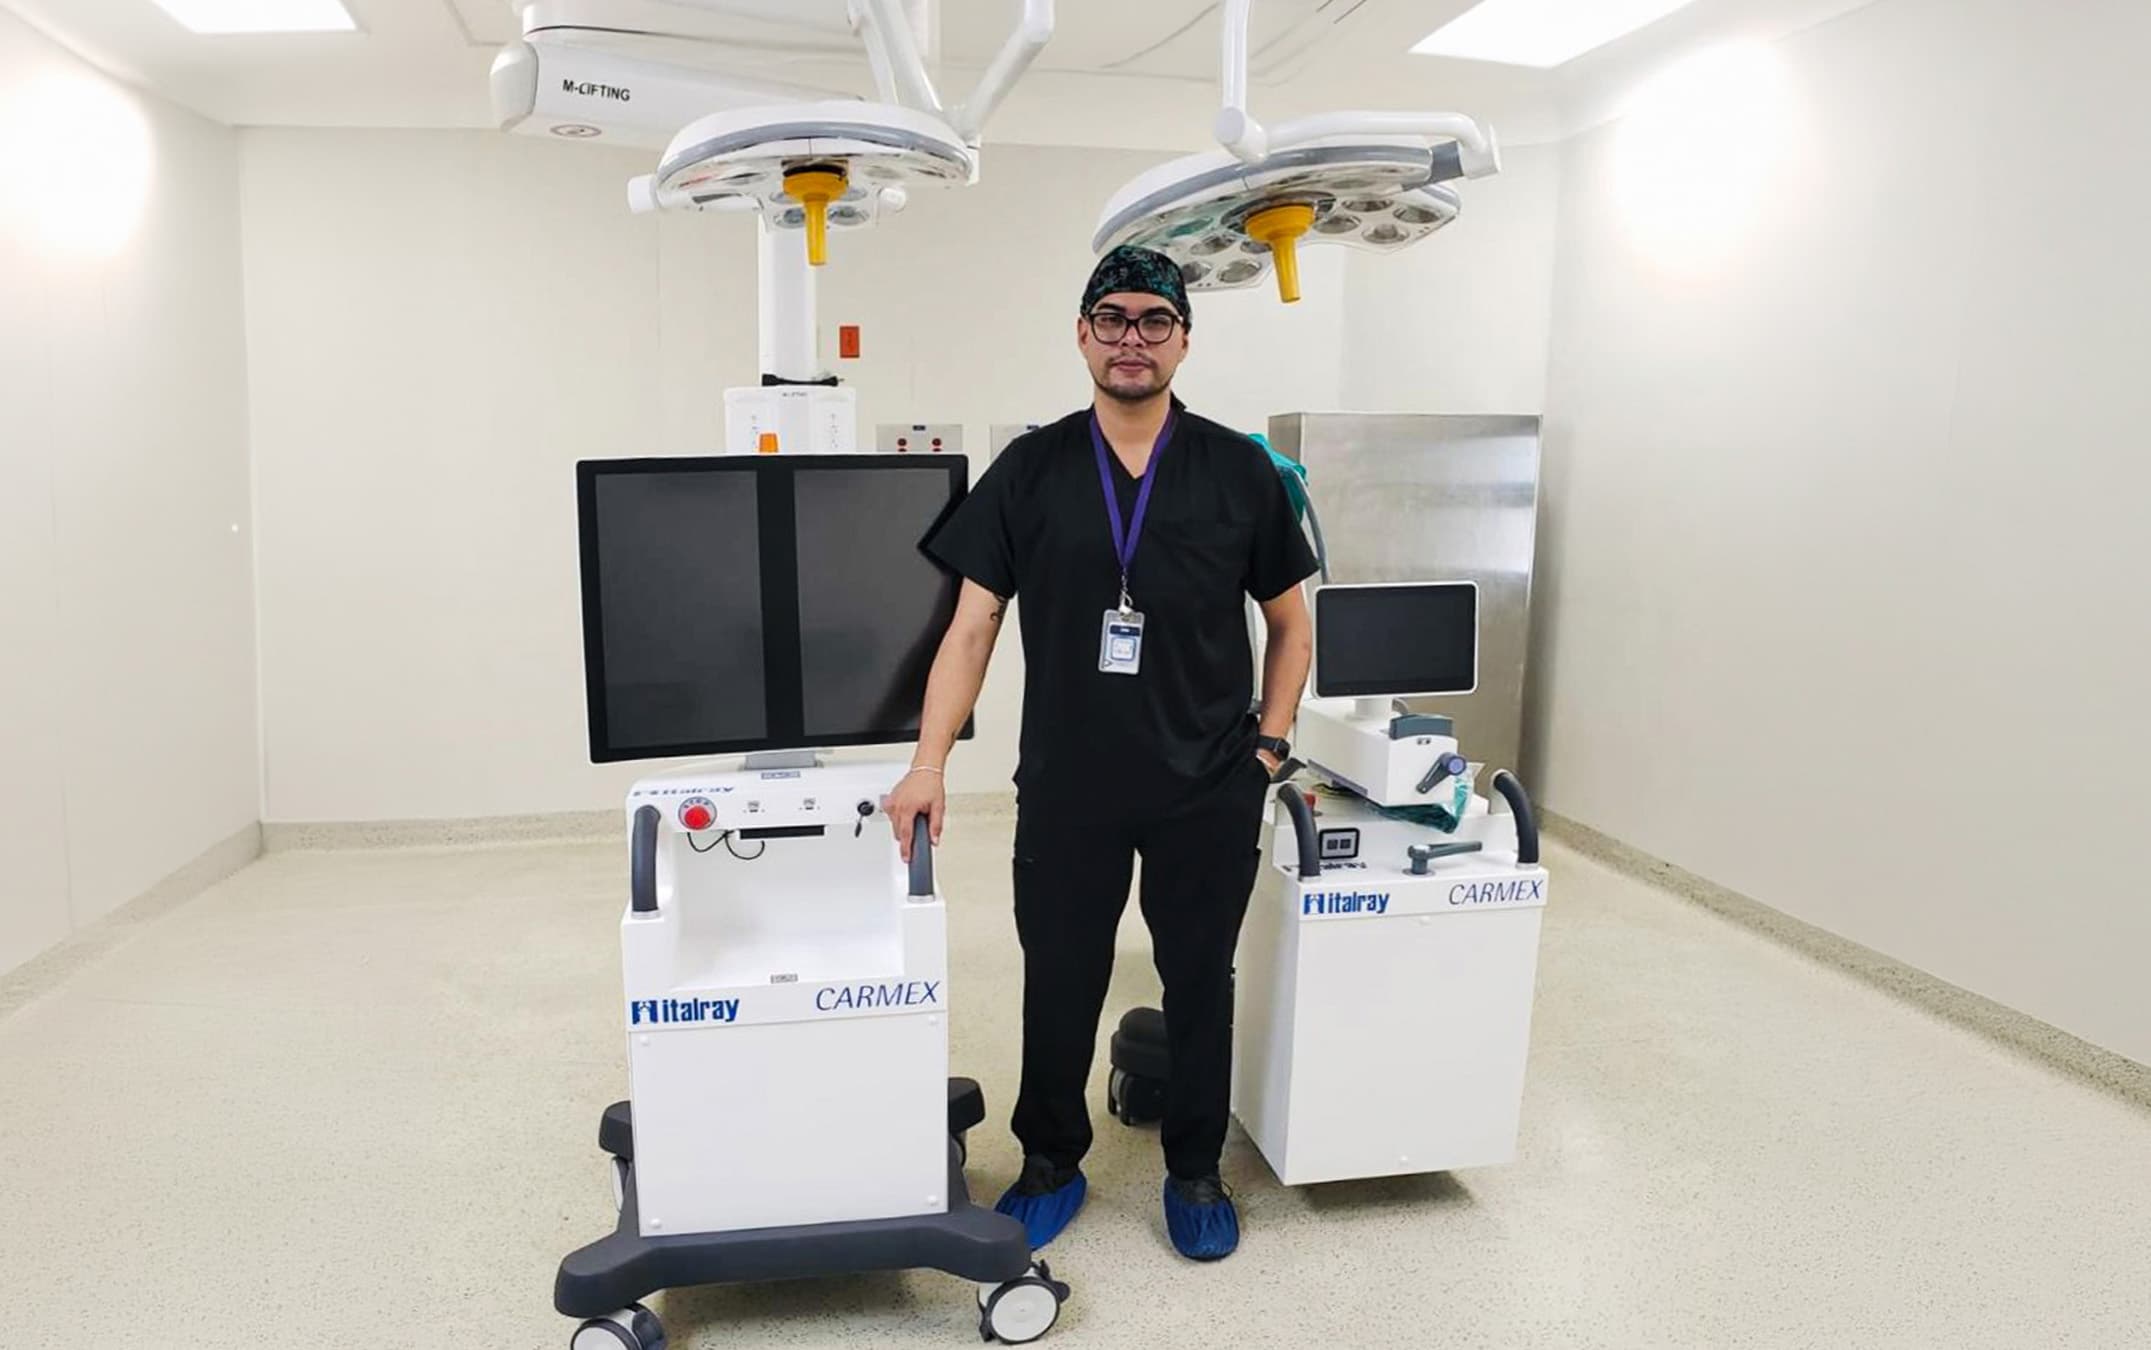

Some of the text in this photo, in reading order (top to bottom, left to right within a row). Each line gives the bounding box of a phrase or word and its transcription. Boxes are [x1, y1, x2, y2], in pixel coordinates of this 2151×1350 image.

[1328, 891, 1390, 914] italray
[1448, 879, 1544, 905] CARMEX
[816, 981, 940, 1011] CARMEX
[662, 997, 740, 1022] italray
